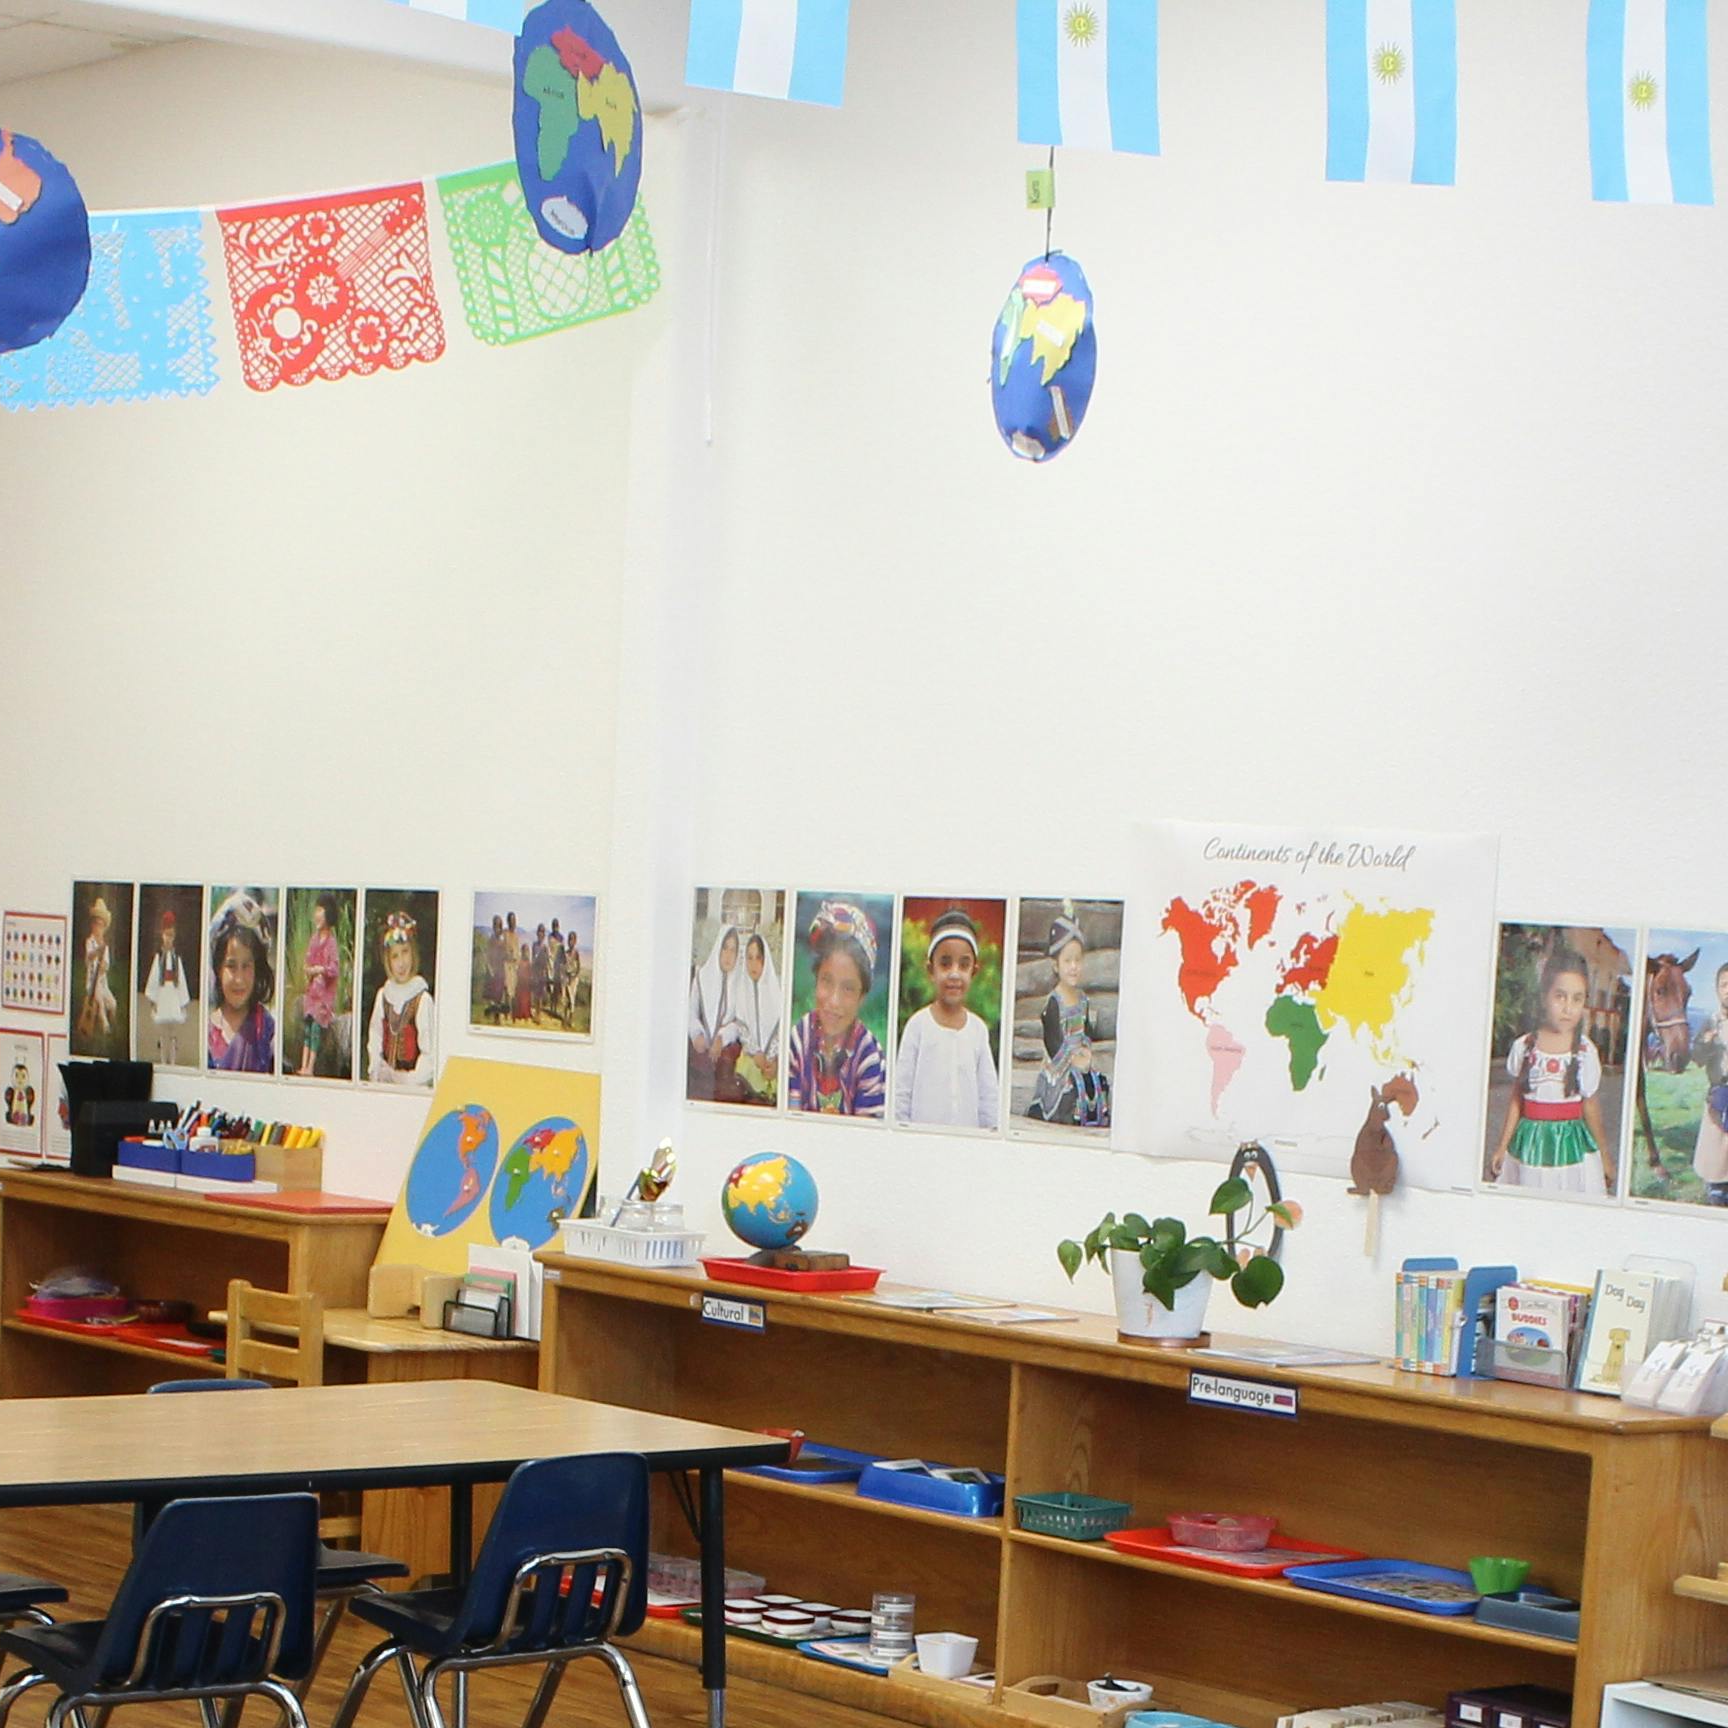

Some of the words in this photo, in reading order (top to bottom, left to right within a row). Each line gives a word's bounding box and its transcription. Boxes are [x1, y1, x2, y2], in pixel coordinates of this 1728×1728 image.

[1202, 836, 1291, 865] Continents
[1294, 840, 1319, 875] of
[1318, 842, 1345, 867] the
[1346, 843, 1417, 873] World
[1604, 1283, 1625, 1302] Dog
[703, 1300, 745, 1321] Cultural
[1626, 1295, 1646, 1314] Day
[1192, 1376, 1271, 1407] Pre-language
